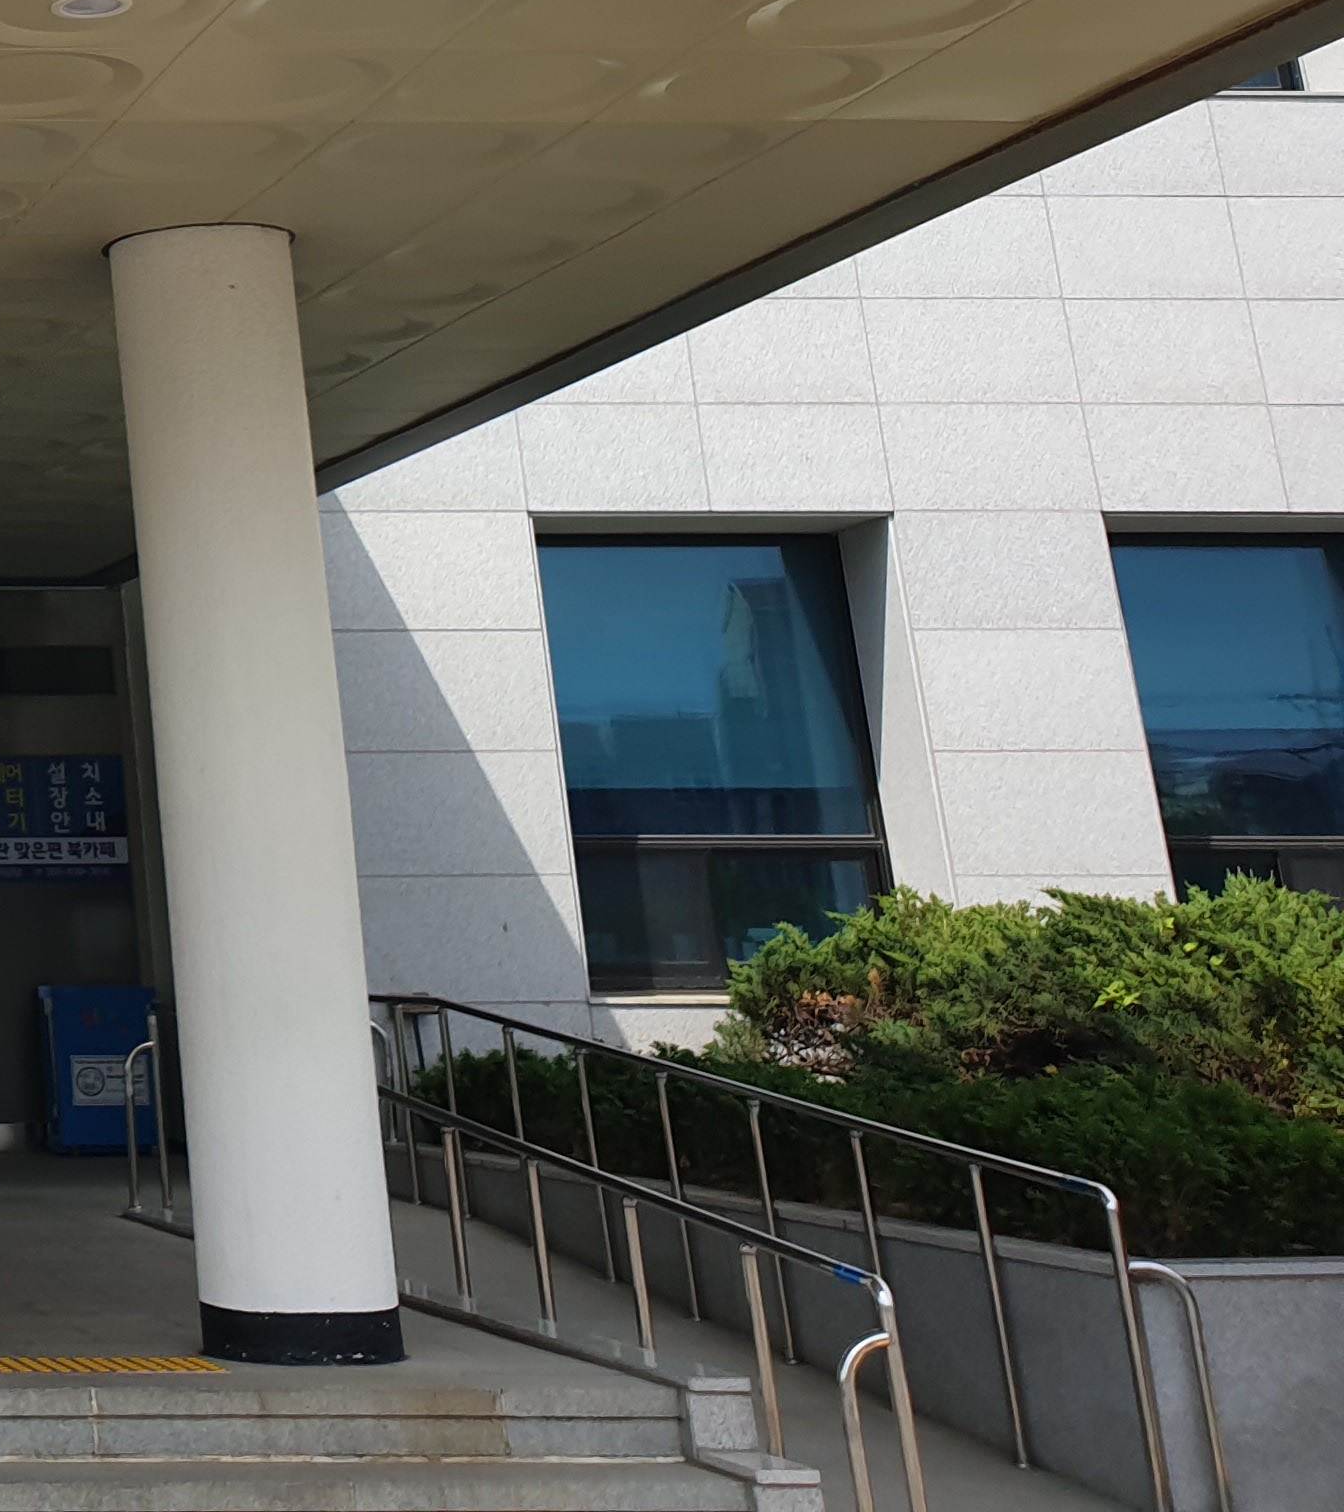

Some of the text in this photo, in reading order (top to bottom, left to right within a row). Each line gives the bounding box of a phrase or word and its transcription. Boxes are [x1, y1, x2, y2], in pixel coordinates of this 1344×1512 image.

[48, 762, 101, 785] 설치
[48, 786, 104, 809] 장소
[50, 811, 106, 833] 안내
[14, 842, 63, 861] 맞은편
[66, 841, 116, 861] 북카페
